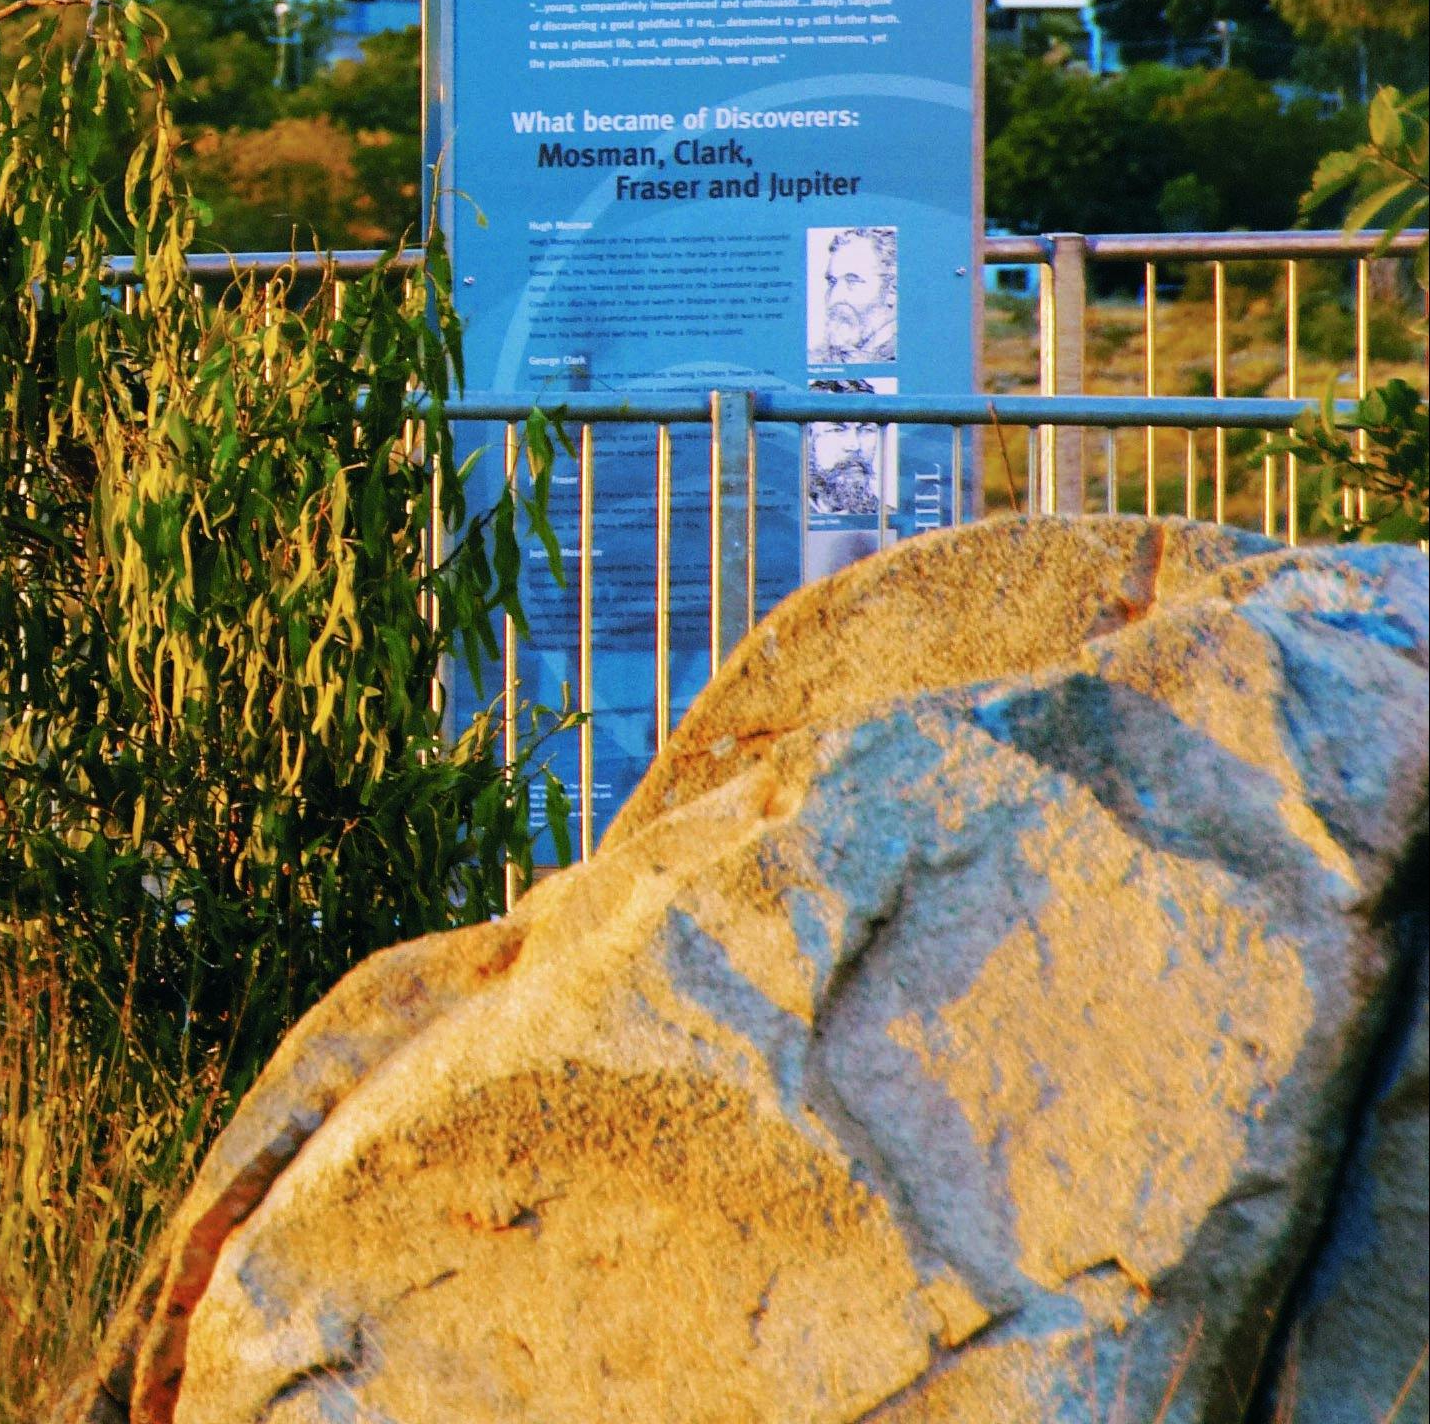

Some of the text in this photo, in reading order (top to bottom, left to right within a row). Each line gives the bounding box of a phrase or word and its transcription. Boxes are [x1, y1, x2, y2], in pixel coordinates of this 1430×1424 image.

[580, 0, 647, 13] comparatively
[529, 21, 539, 30] of
[543, 19, 597, 32] discovering
[609, 19, 634, 31] good
[783, 17, 794, 25] to
[796, 18, 810, 27] go
[812, 15, 831, 25] still
[833, 14, 867, 25] further
[571, 38, 613, 50] pleasant
[661, 36, 705, 49] although
[707, 35, 788, 48] disappointments
[871, 34, 886, 45] yet
[528, 58, 545, 68] the
[621, 56, 671, 67] somewhat
[725, 57, 749, 65] were
[512, 107, 861, 134] What became of Discoverers:
[538, 139, 753, 171] Mosman, Clark,
[616, 170, 861, 203] Fraser and Jupiter
[529, 221, 553, 232] Hugh
[528, 355, 586, 367] George Clark
